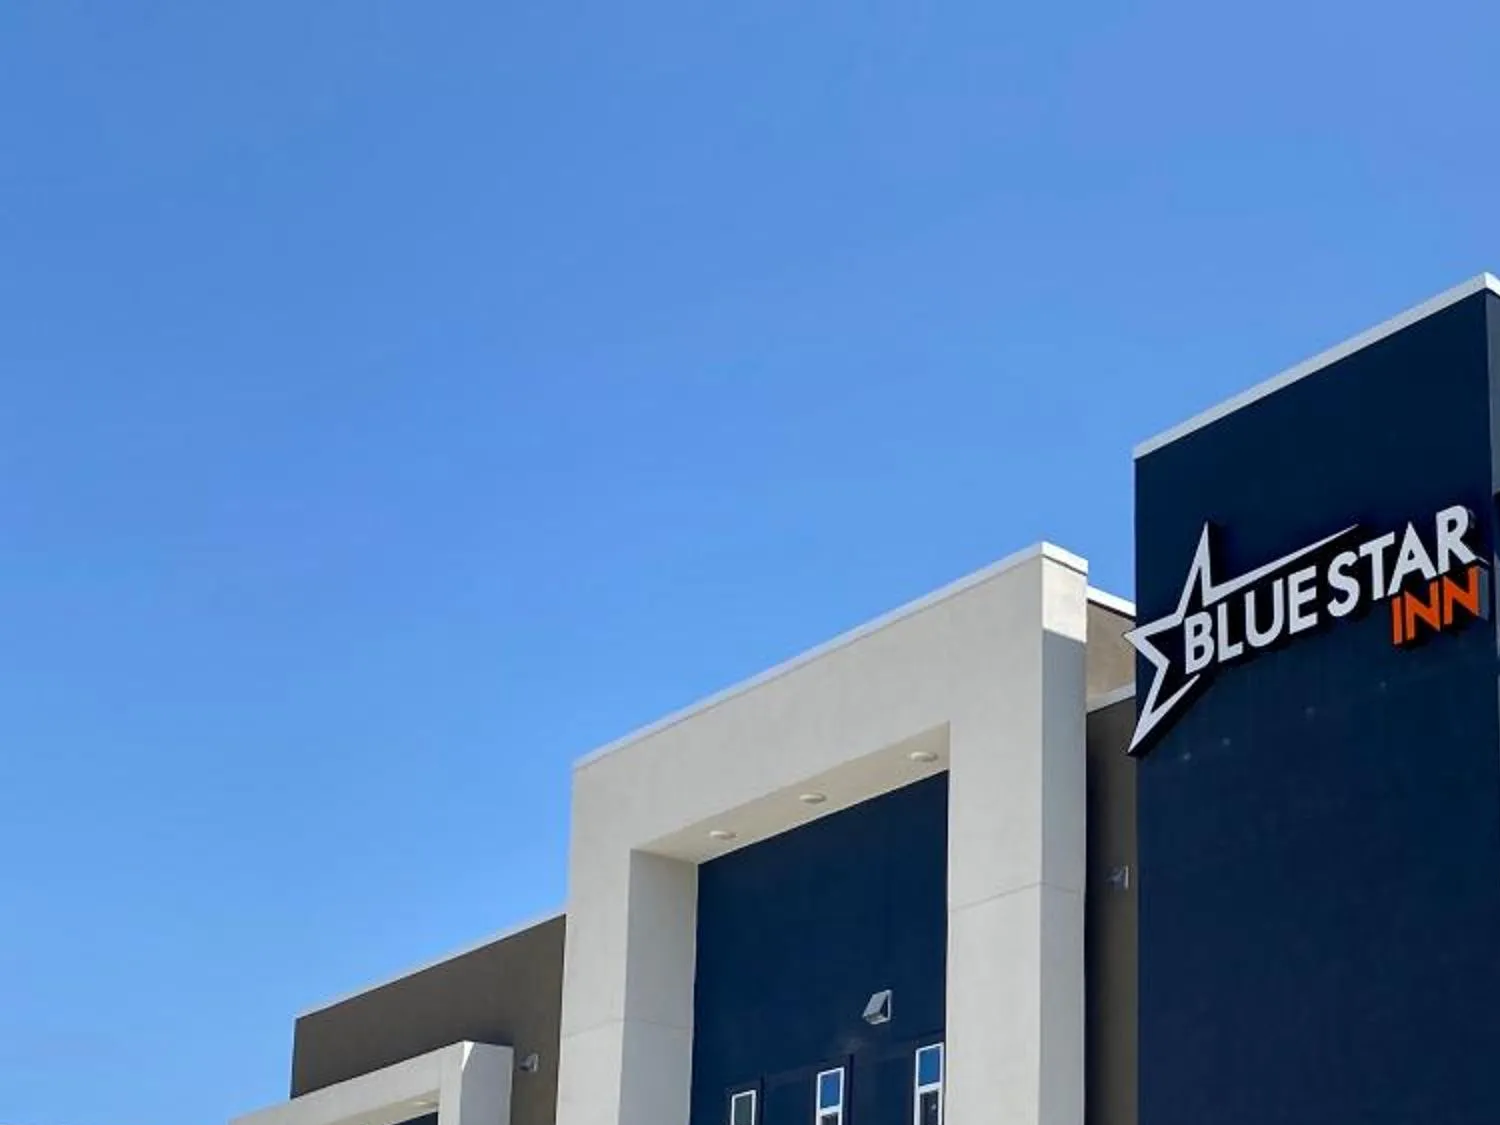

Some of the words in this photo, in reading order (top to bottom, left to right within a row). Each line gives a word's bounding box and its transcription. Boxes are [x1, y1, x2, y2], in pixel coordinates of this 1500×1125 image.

[1184, 564, 1319, 675] BLUE
[1327, 504, 1479, 618] STAR
[1391, 565, 1481, 645] INN
